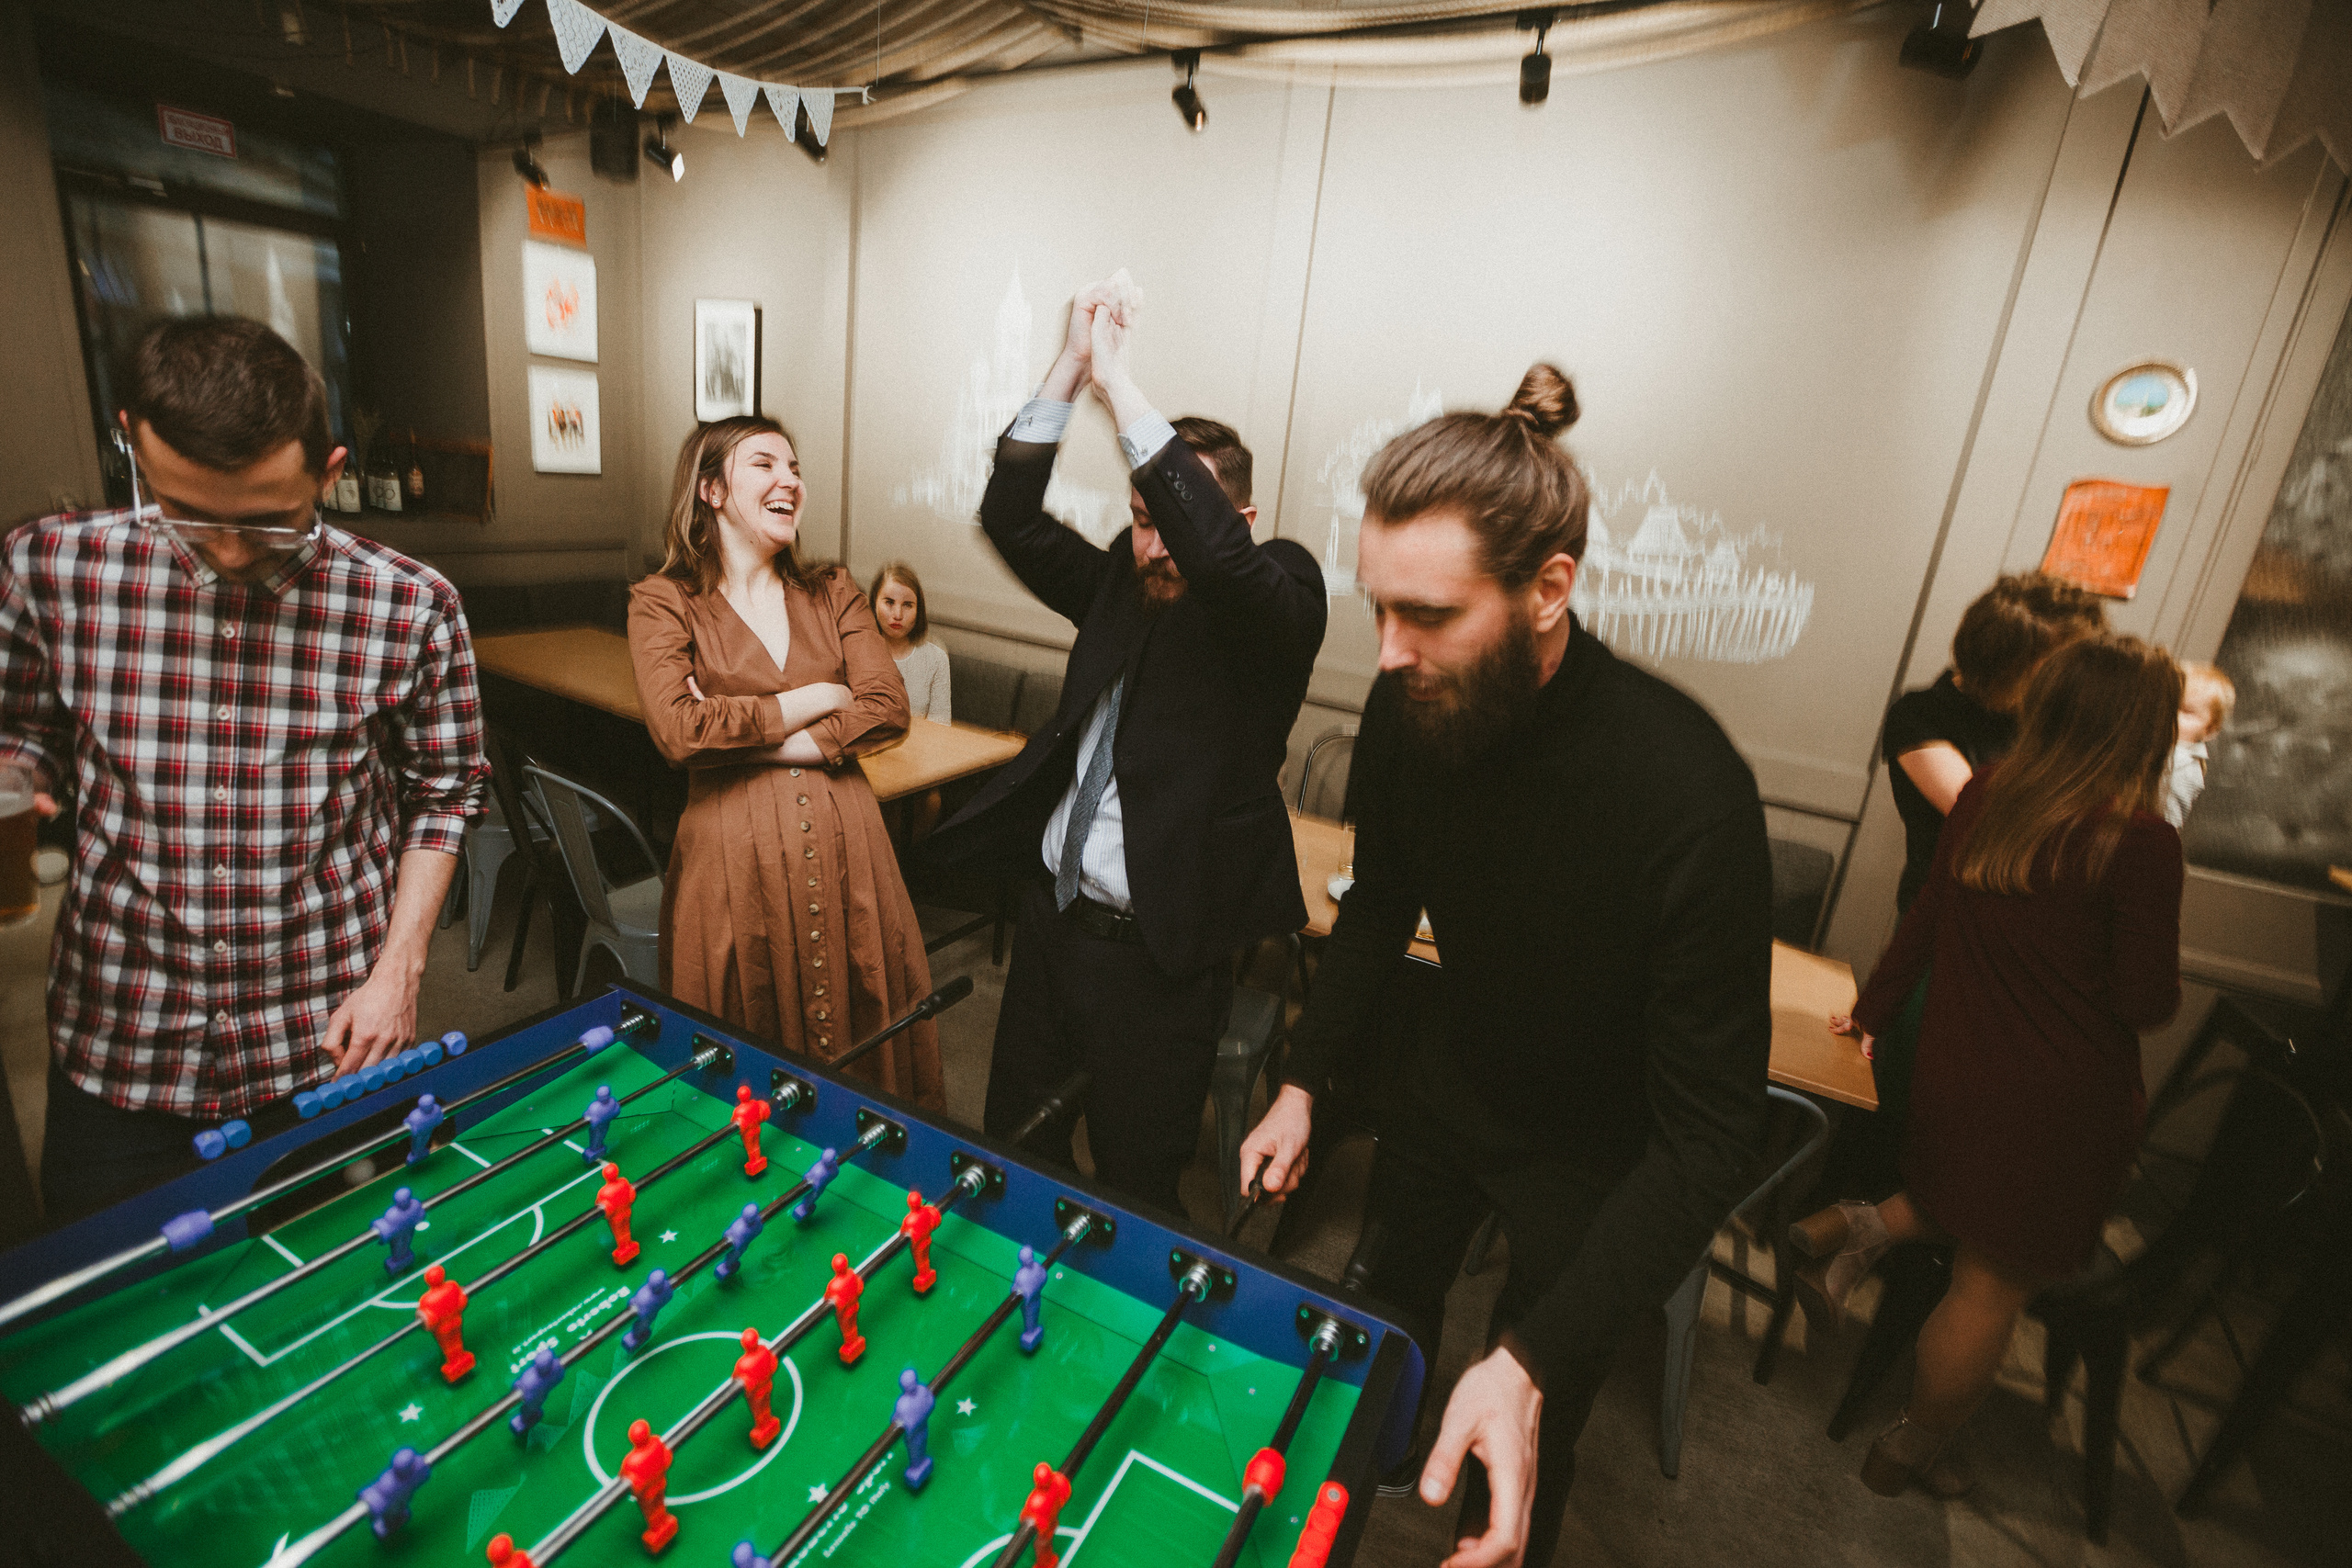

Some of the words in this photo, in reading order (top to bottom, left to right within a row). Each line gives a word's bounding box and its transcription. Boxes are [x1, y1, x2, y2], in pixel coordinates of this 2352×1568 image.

[174, 127, 223, 150] ВЫХОД
[566, 1285, 630, 1332] Roberto
[510, 1336, 559, 1374] Sport
